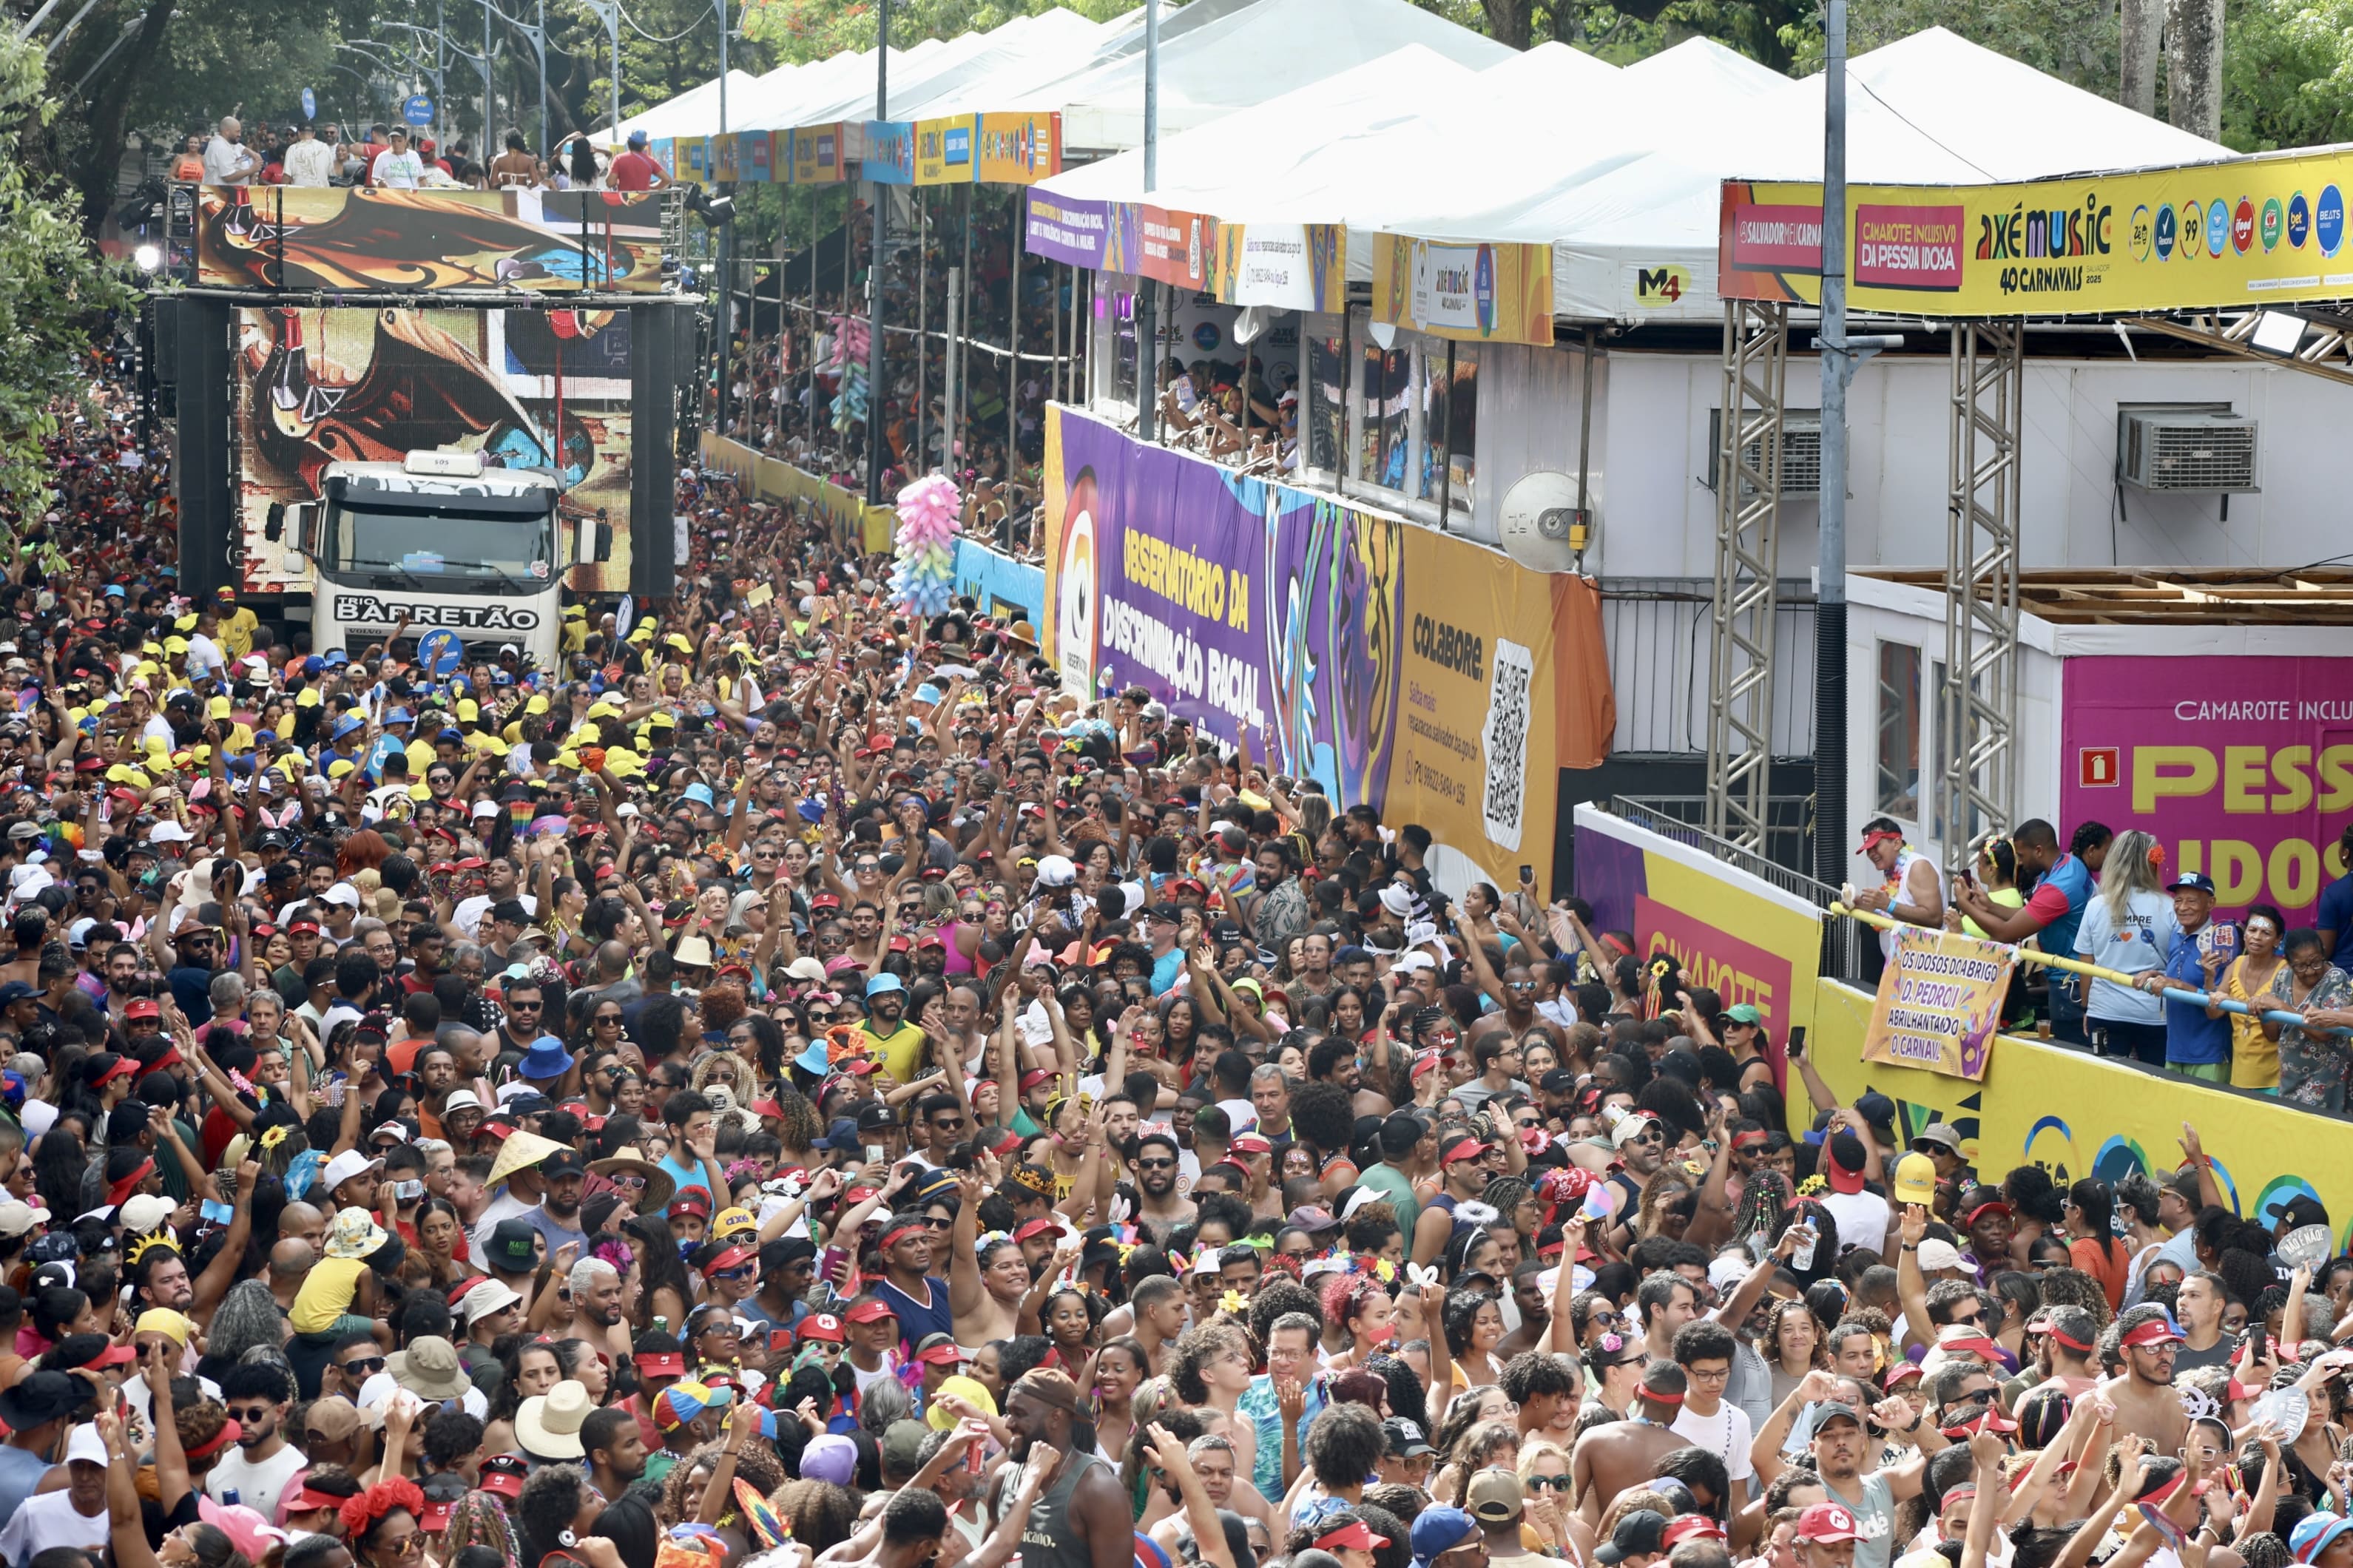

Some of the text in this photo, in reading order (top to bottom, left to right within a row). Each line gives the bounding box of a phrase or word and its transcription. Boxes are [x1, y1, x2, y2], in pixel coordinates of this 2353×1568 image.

[1863, 222, 1957, 243] CAMAROTE INCLUSIVO
[2185, 219, 2198, 241] 99
[1862, 244, 1955, 271] DA PESSOA IDOSA
[1638, 268, 1681, 303] M4
[2000, 266, 2083, 296] 40 CARNAVAIS
[2086, 275, 2102, 284] 2025
[1124, 526, 1249, 633] OBSERVATÓRIO DA
[338, 597, 376, 606] TRIO
[1103, 594, 1203, 700] DISCRIMINAÇÃO
[1408, 680, 1423, 706] Saiba
[2174, 700, 2289, 720] CAMAROTE
[1902, 951, 1914, 969] OS
[1915, 952, 1948, 974] IDOSOS
[1891, 1035, 1898, 1054] O
[2283, 1228, 2324, 1255] NÃO É NÃO!
